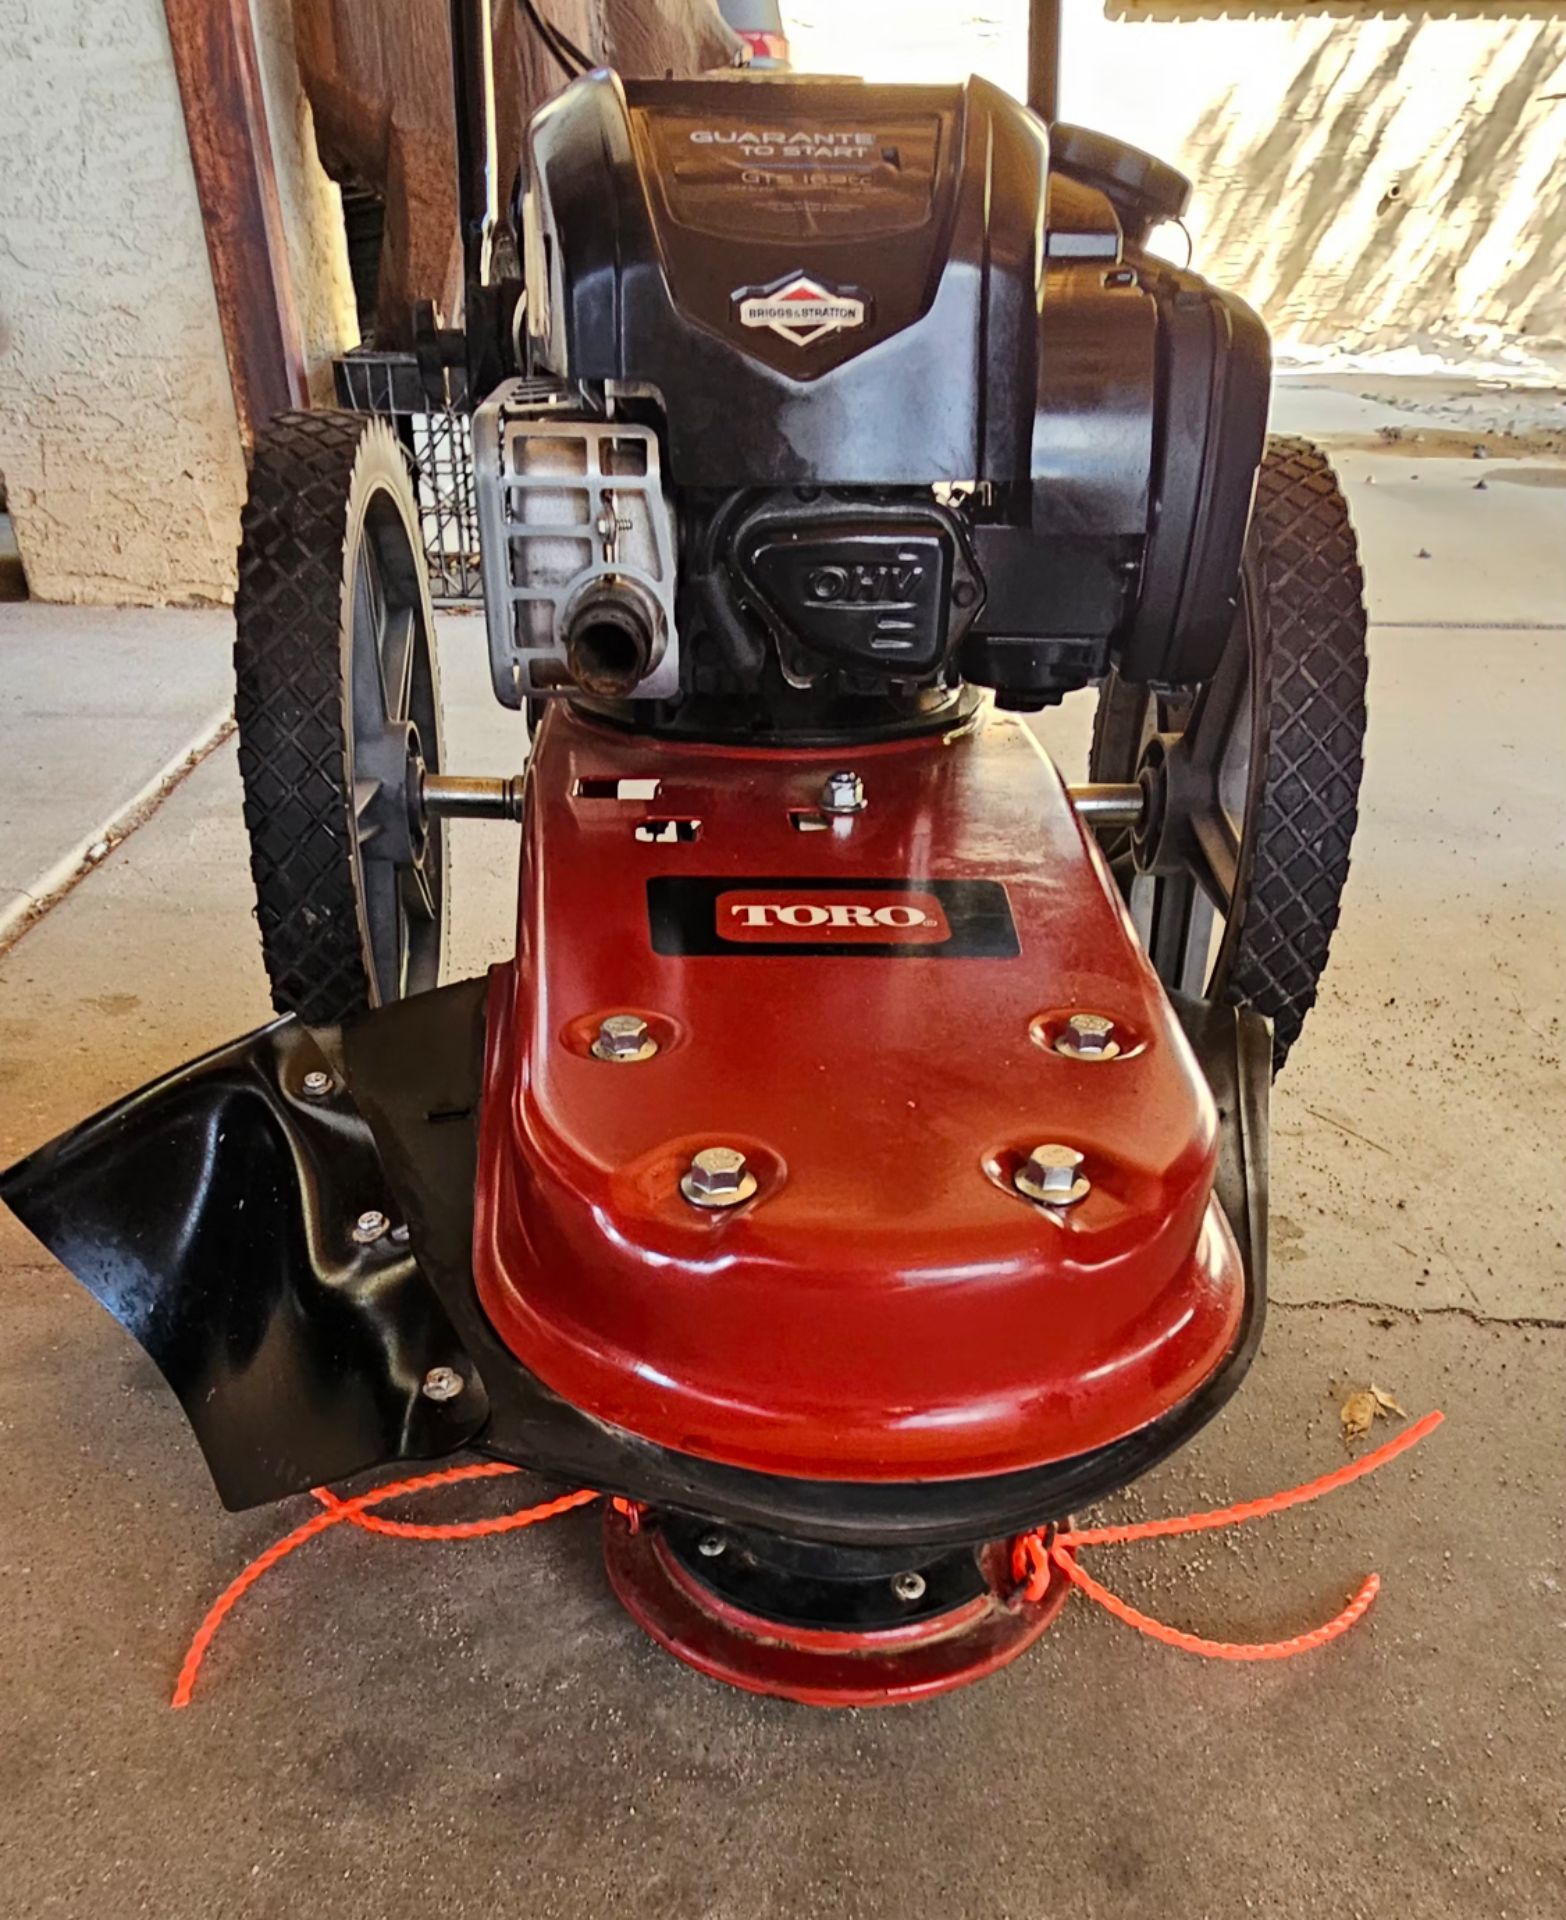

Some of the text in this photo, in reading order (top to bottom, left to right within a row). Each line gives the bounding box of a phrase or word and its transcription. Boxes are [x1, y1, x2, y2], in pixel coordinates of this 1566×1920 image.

[739, 145, 868, 158] TO START
[803, 565, 924, 601] OHV
[731, 904, 926, 927] TORO
